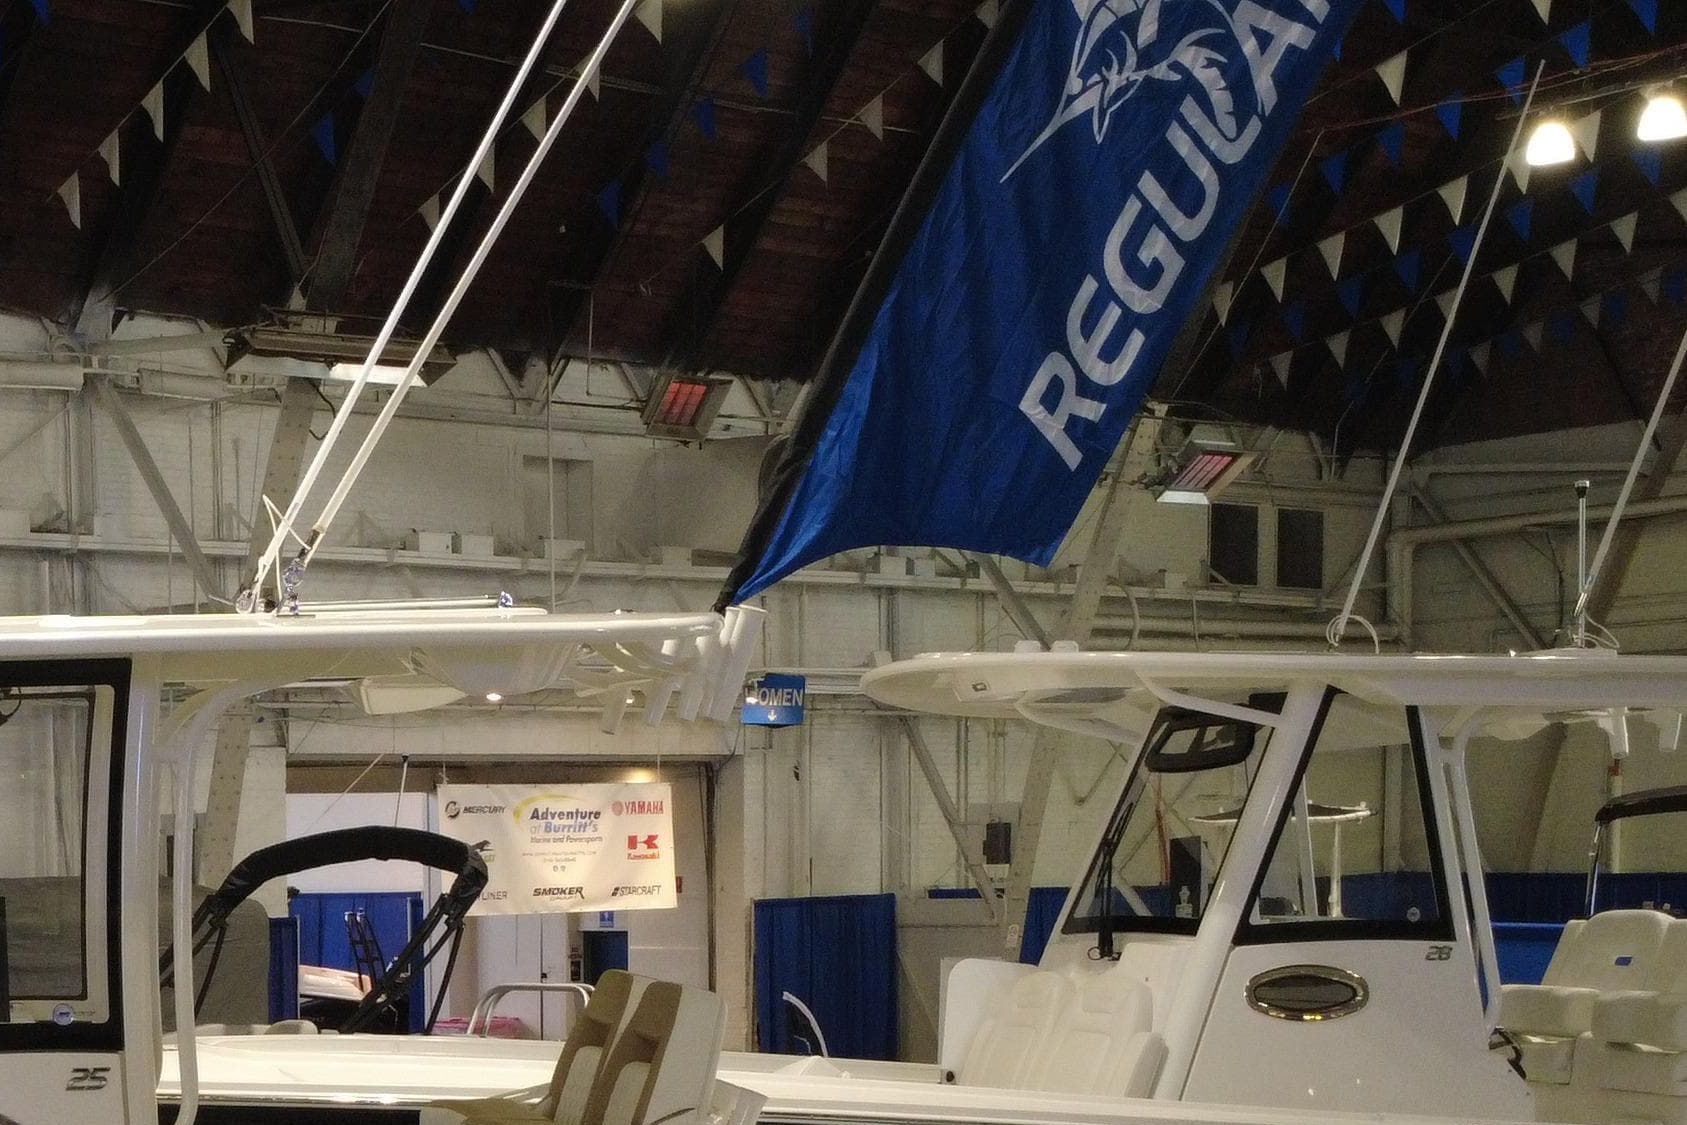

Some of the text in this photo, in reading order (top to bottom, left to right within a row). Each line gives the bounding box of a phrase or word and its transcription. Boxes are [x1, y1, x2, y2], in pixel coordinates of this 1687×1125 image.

[744, 687, 804, 706] OMEN
[463, 805, 507, 815] MERCURY
[530, 806, 602, 821] Adventure
[624, 800, 664, 815] YAMAHA
[544, 819, 599, 833] Burritt's
[552, 834, 565, 843] and
[533, 886, 585, 899] SMOKER
[620, 884, 662, 897] STARCRAFT
[65, 1066, 111, 1091] 25
